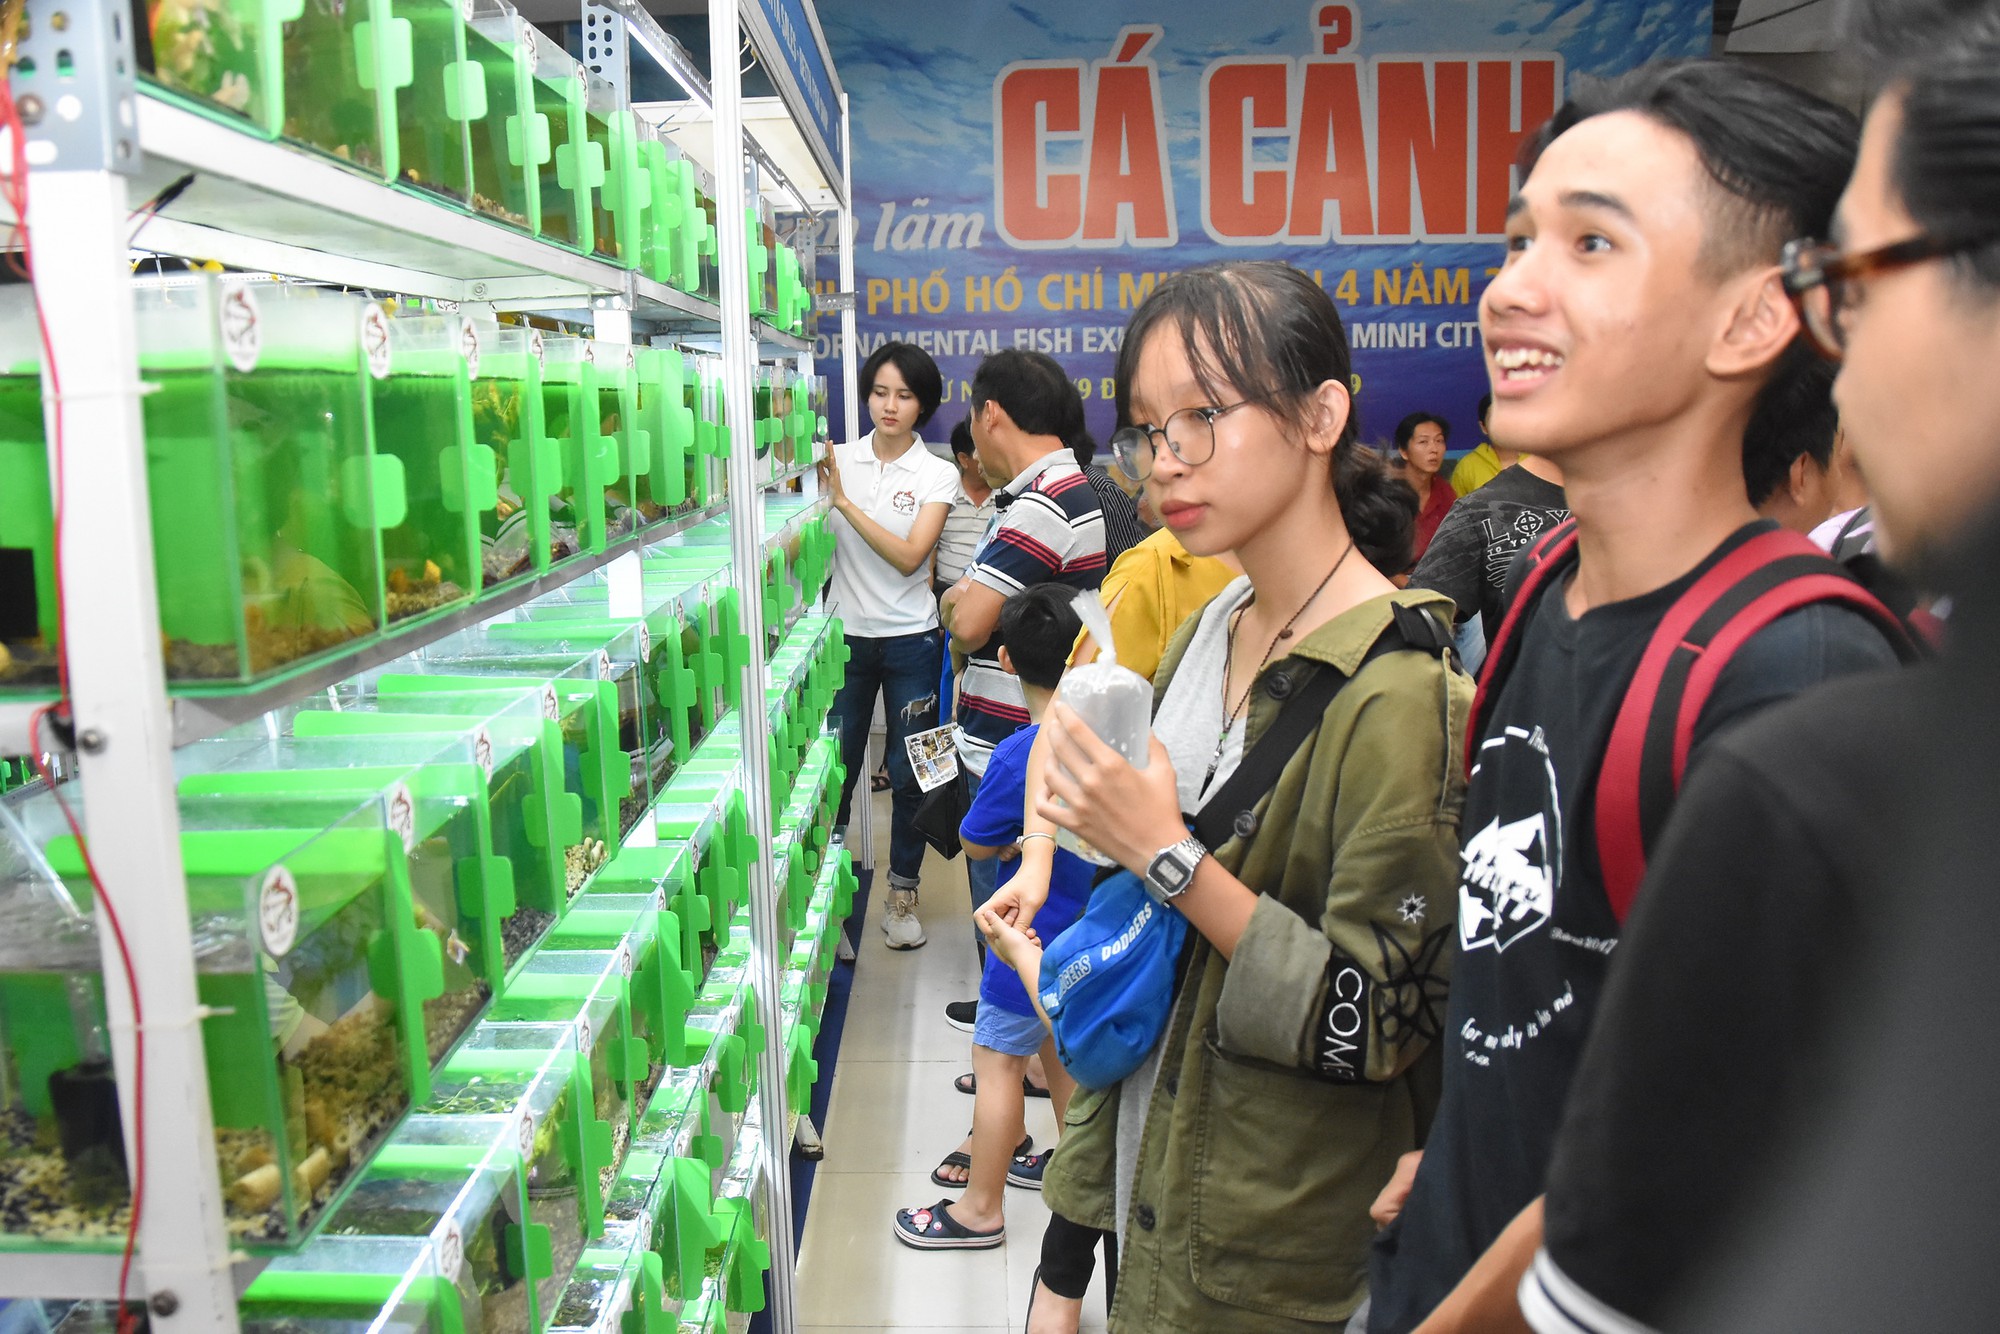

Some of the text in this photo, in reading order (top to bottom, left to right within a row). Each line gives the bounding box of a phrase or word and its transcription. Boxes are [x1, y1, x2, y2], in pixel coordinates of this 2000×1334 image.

[998, 29, 1173, 244] CÁ
[1206, 2, 1559, 241] CẢNH
[873, 197, 985, 252] lãm
[866, 267, 951, 316] PHỐ
[1037, 265, 1104, 312] CHÍ
[1334, 268, 1361, 306] 4
[1373, 261, 1470, 306] NĂM
[1013, 326, 1073, 354] FISH
[1352, 321, 1427, 349] MINH
[1435, 320, 1482, 348] CIT
[1101, 901, 1153, 962] DODGERS
